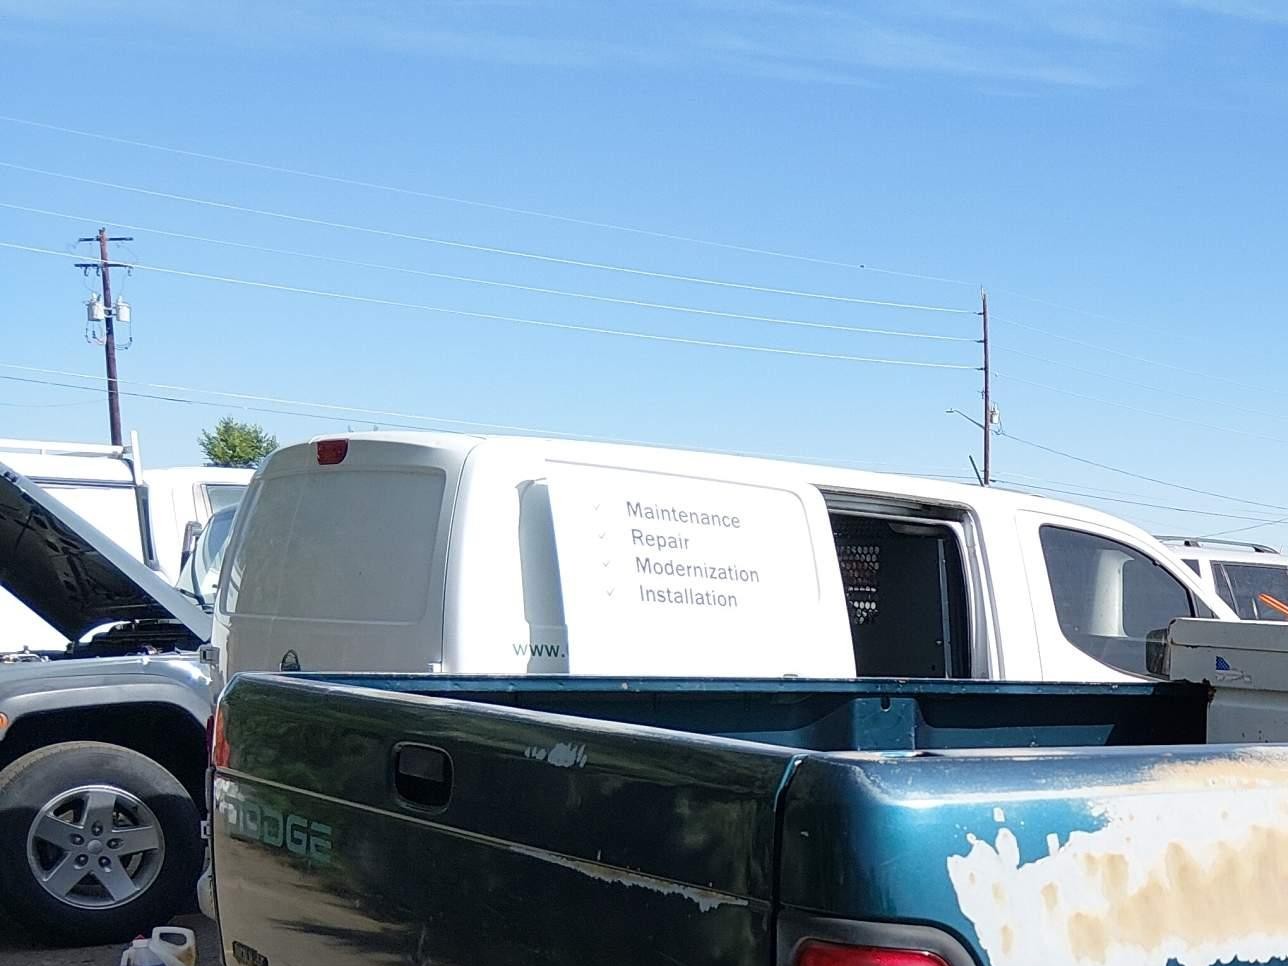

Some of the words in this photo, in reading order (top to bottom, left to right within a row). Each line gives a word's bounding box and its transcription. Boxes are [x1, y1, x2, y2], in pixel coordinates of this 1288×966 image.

[626, 501, 741, 529] Maintenance
[631, 528, 691, 551] Repair
[636, 556, 760, 583] Modernization
[640, 585, 738, 608] Installation
[513, 643, 566, 658] www.
[224, 796, 333, 866] DODGE
